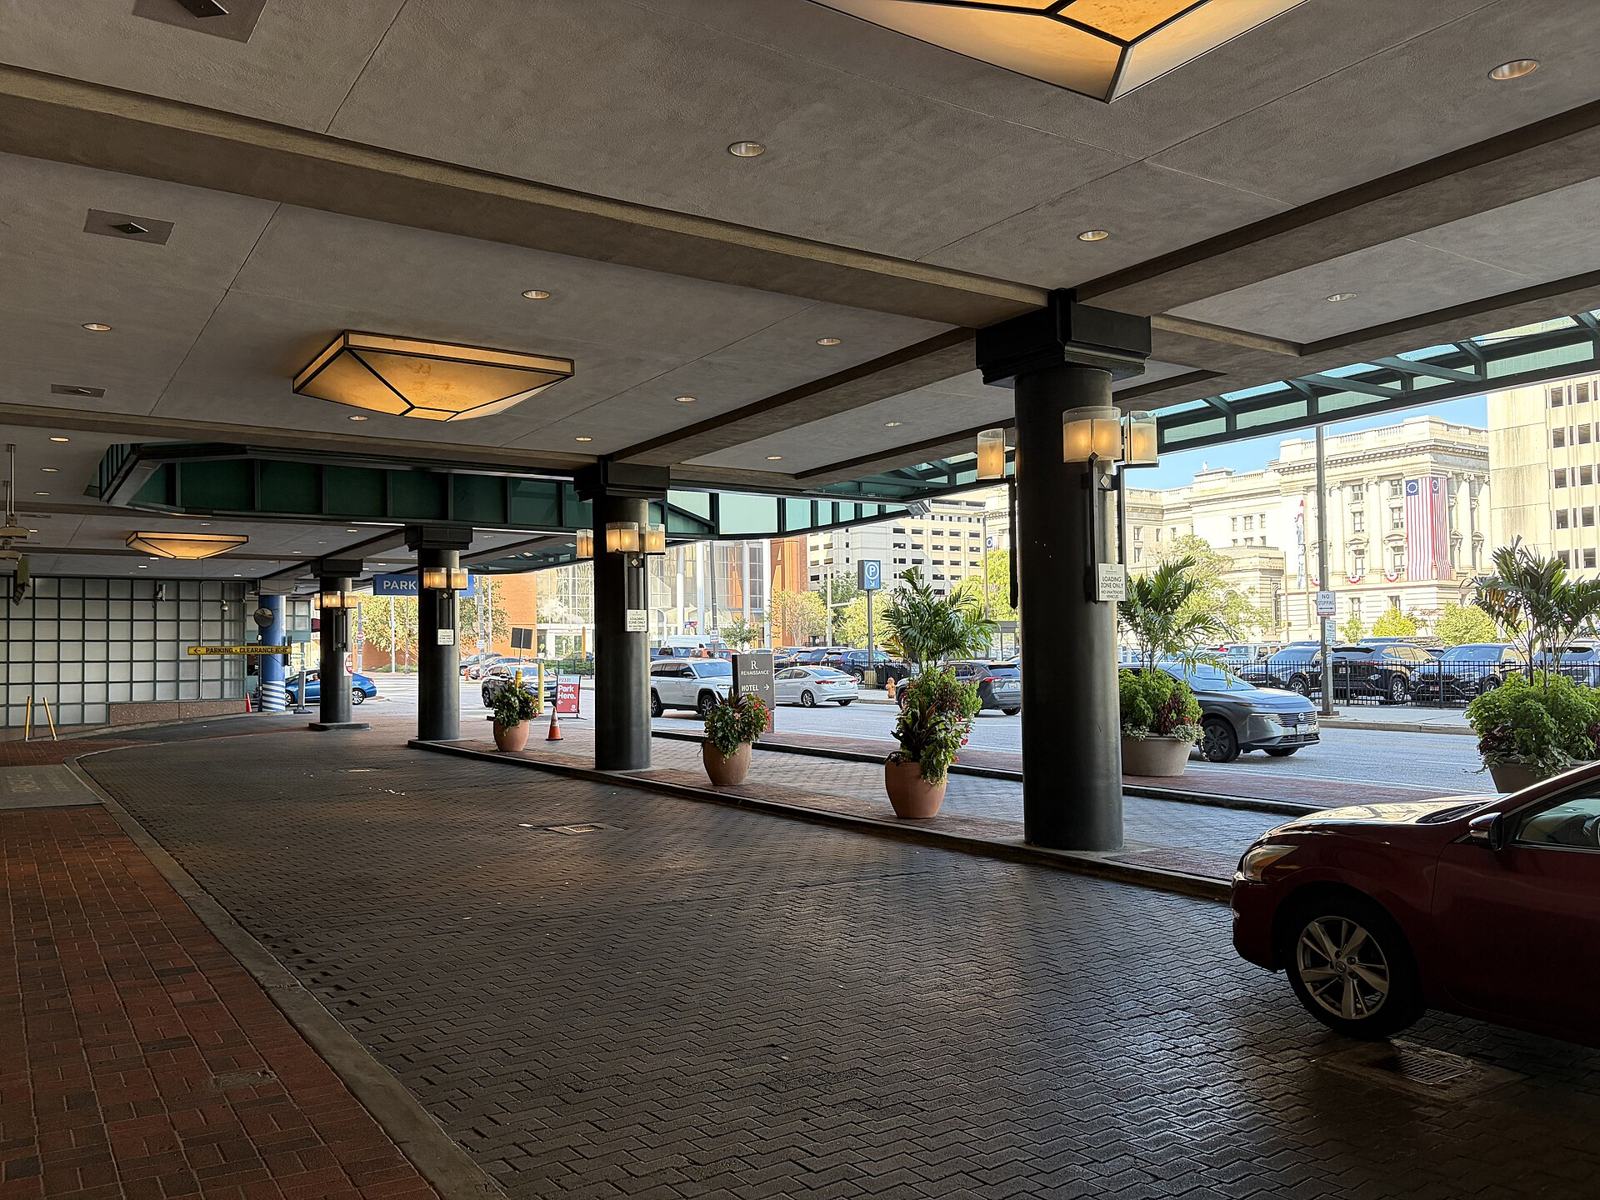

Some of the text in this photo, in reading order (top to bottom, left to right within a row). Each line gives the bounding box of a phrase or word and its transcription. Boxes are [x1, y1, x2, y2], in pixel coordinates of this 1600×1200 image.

[751, 660, 758, 670] R
[557, 684, 575, 693] Park
[741, 684, 759, 692] HOTEL
[557, 692, 577, 700] Here.
